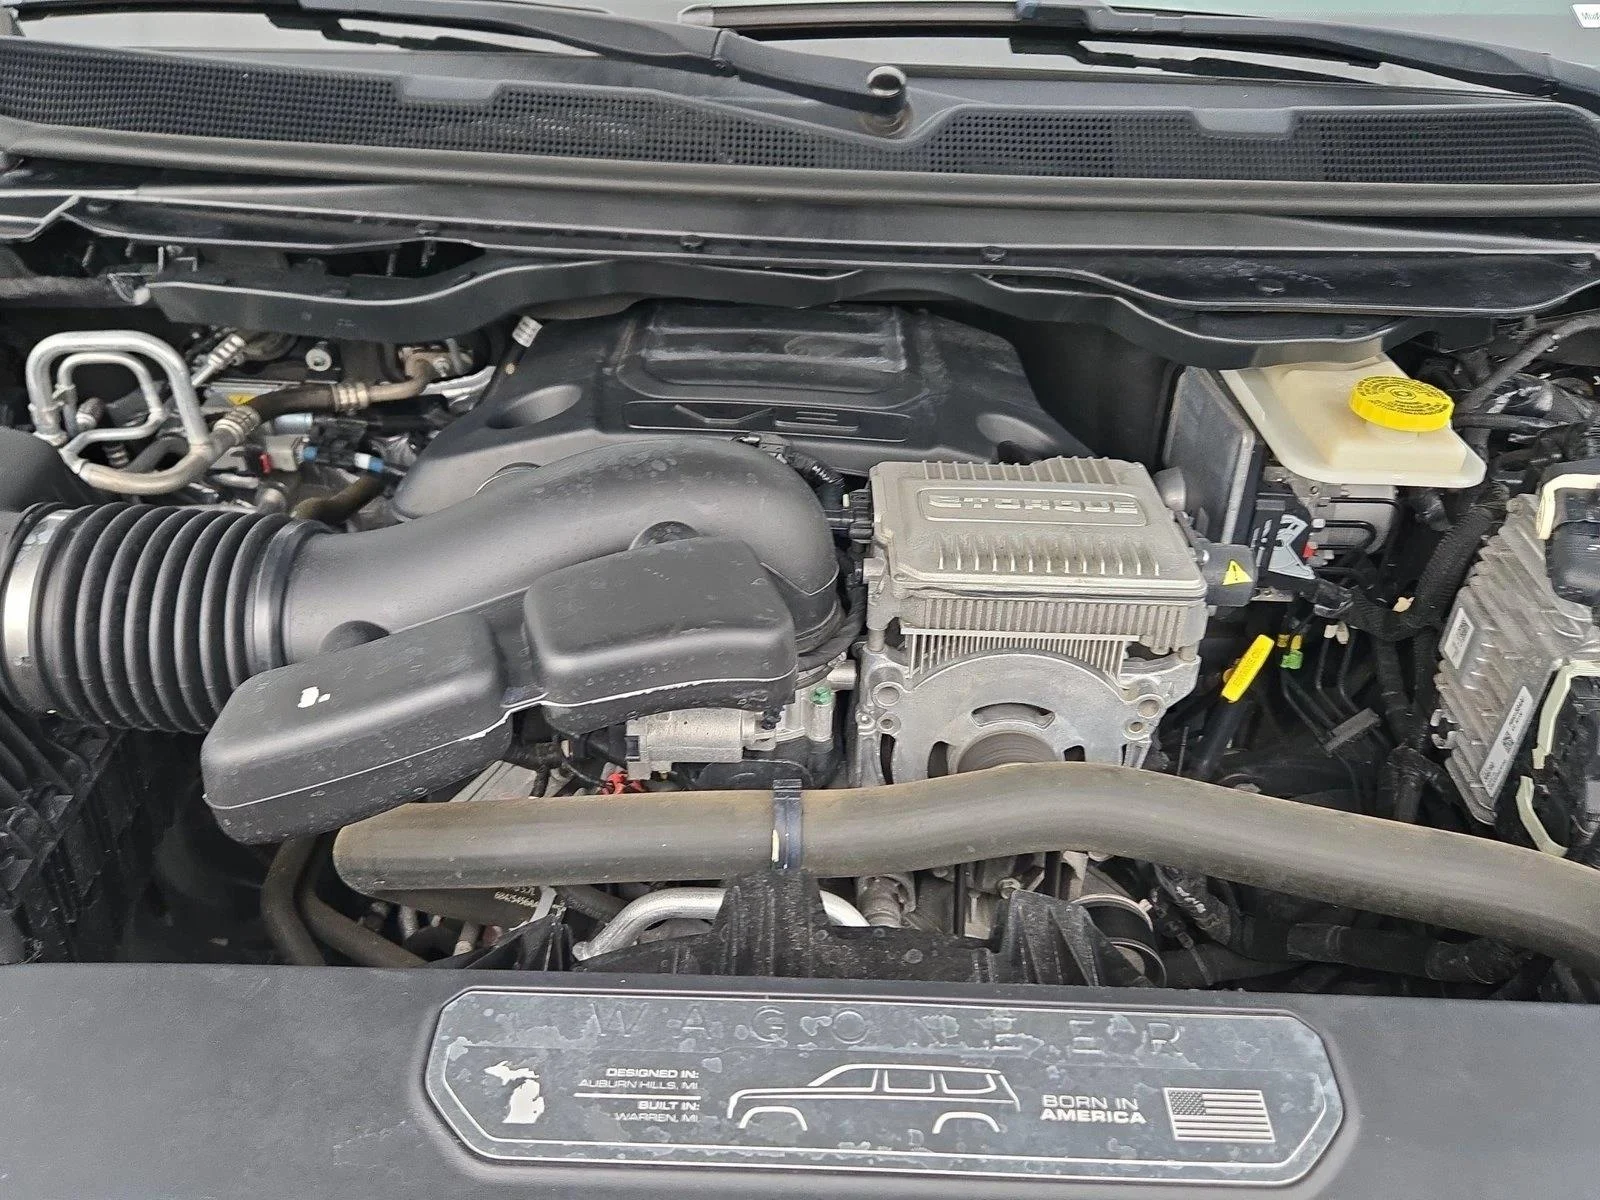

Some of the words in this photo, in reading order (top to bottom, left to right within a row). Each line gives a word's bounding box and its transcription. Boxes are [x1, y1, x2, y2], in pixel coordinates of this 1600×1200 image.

[606, 1067, 679, 1079] DESIGNED
[681, 1069, 700, 1079] IN:
[578, 1079, 638, 1089] AUBURN
[681, 1081, 699, 1090] MI
[637, 1100, 680, 1111] BUILT
[680, 1101, 700, 1111] IN:
[1041, 1094, 1109, 1111] BORN
[1114, 1097, 1140, 1112] IN
[614, 1112, 680, 1123] WARREN,
[1040, 1108, 1147, 1125] AMERICA
